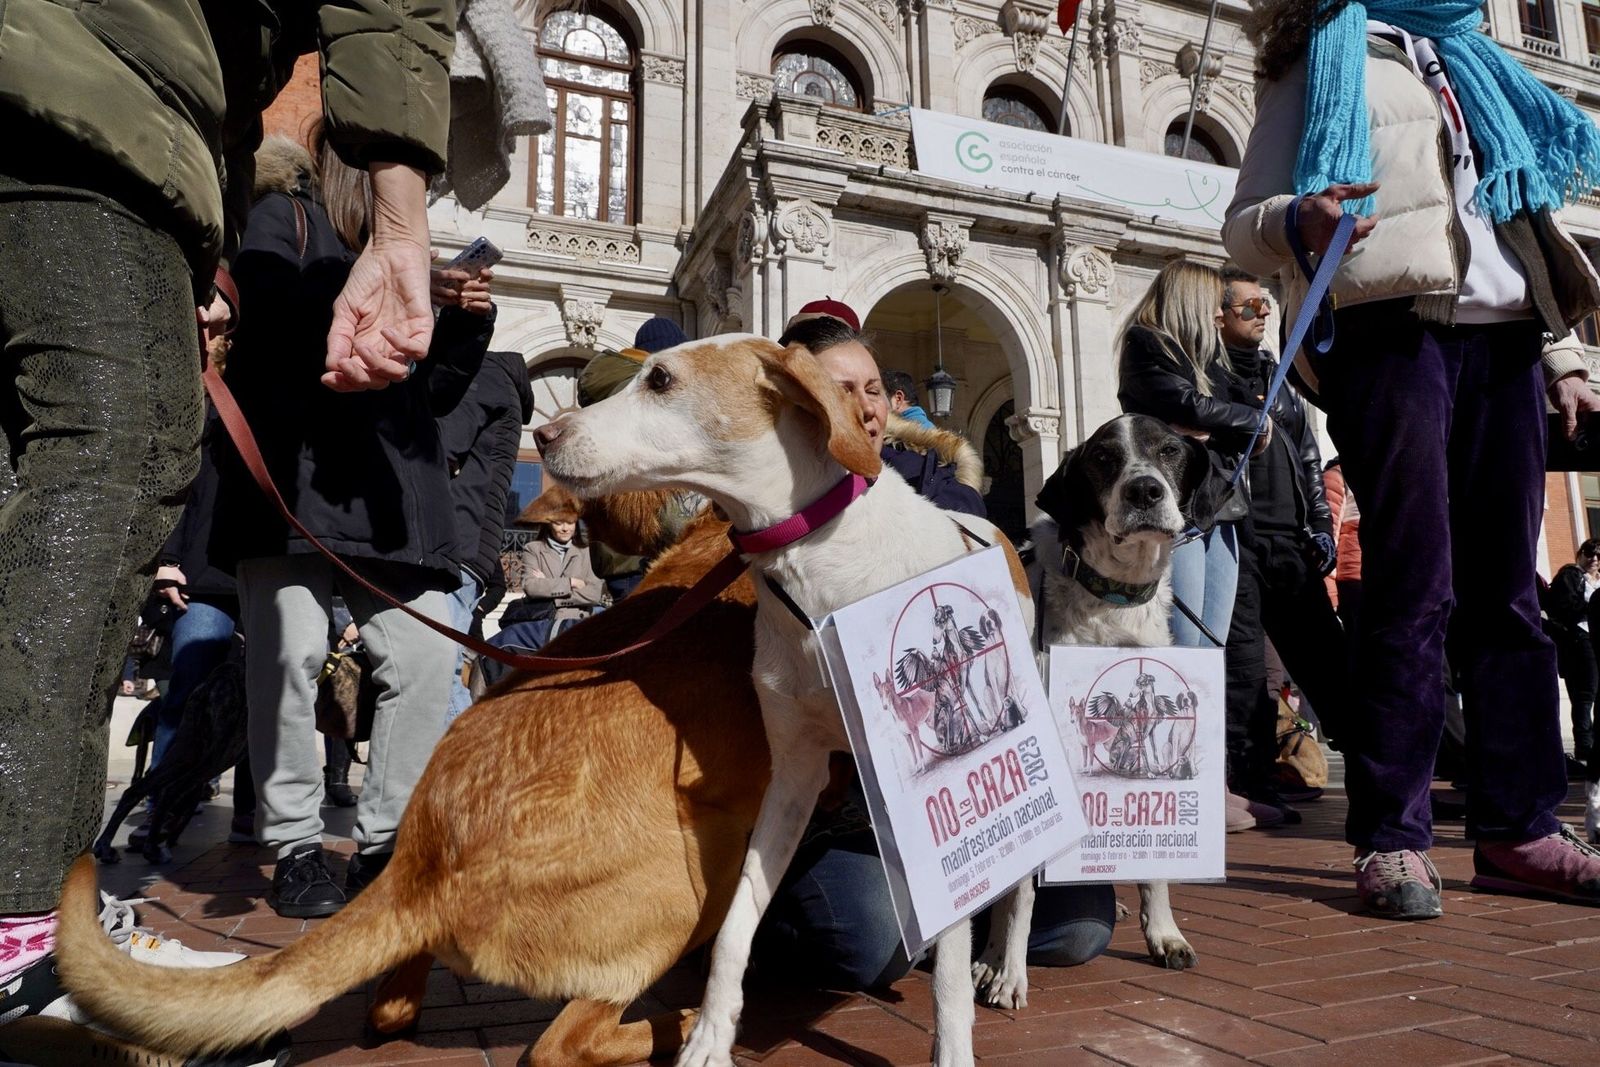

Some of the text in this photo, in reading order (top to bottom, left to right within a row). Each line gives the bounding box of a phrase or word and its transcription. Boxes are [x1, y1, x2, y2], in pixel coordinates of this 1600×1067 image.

[1000, 140, 1052, 153] asociación
[1000, 152, 1046, 165] española
[1001, 165, 1080, 181] contra el cáncer
[966, 748, 1027, 819] CAZA
[1017, 735, 1048, 787] 2023
[1124, 791, 1176, 827] CAZA
[1179, 790, 1199, 826] 2023
[941, 786, 1058, 877] manifestación nacional
[1081, 830, 1198, 849] manifestación nacional
